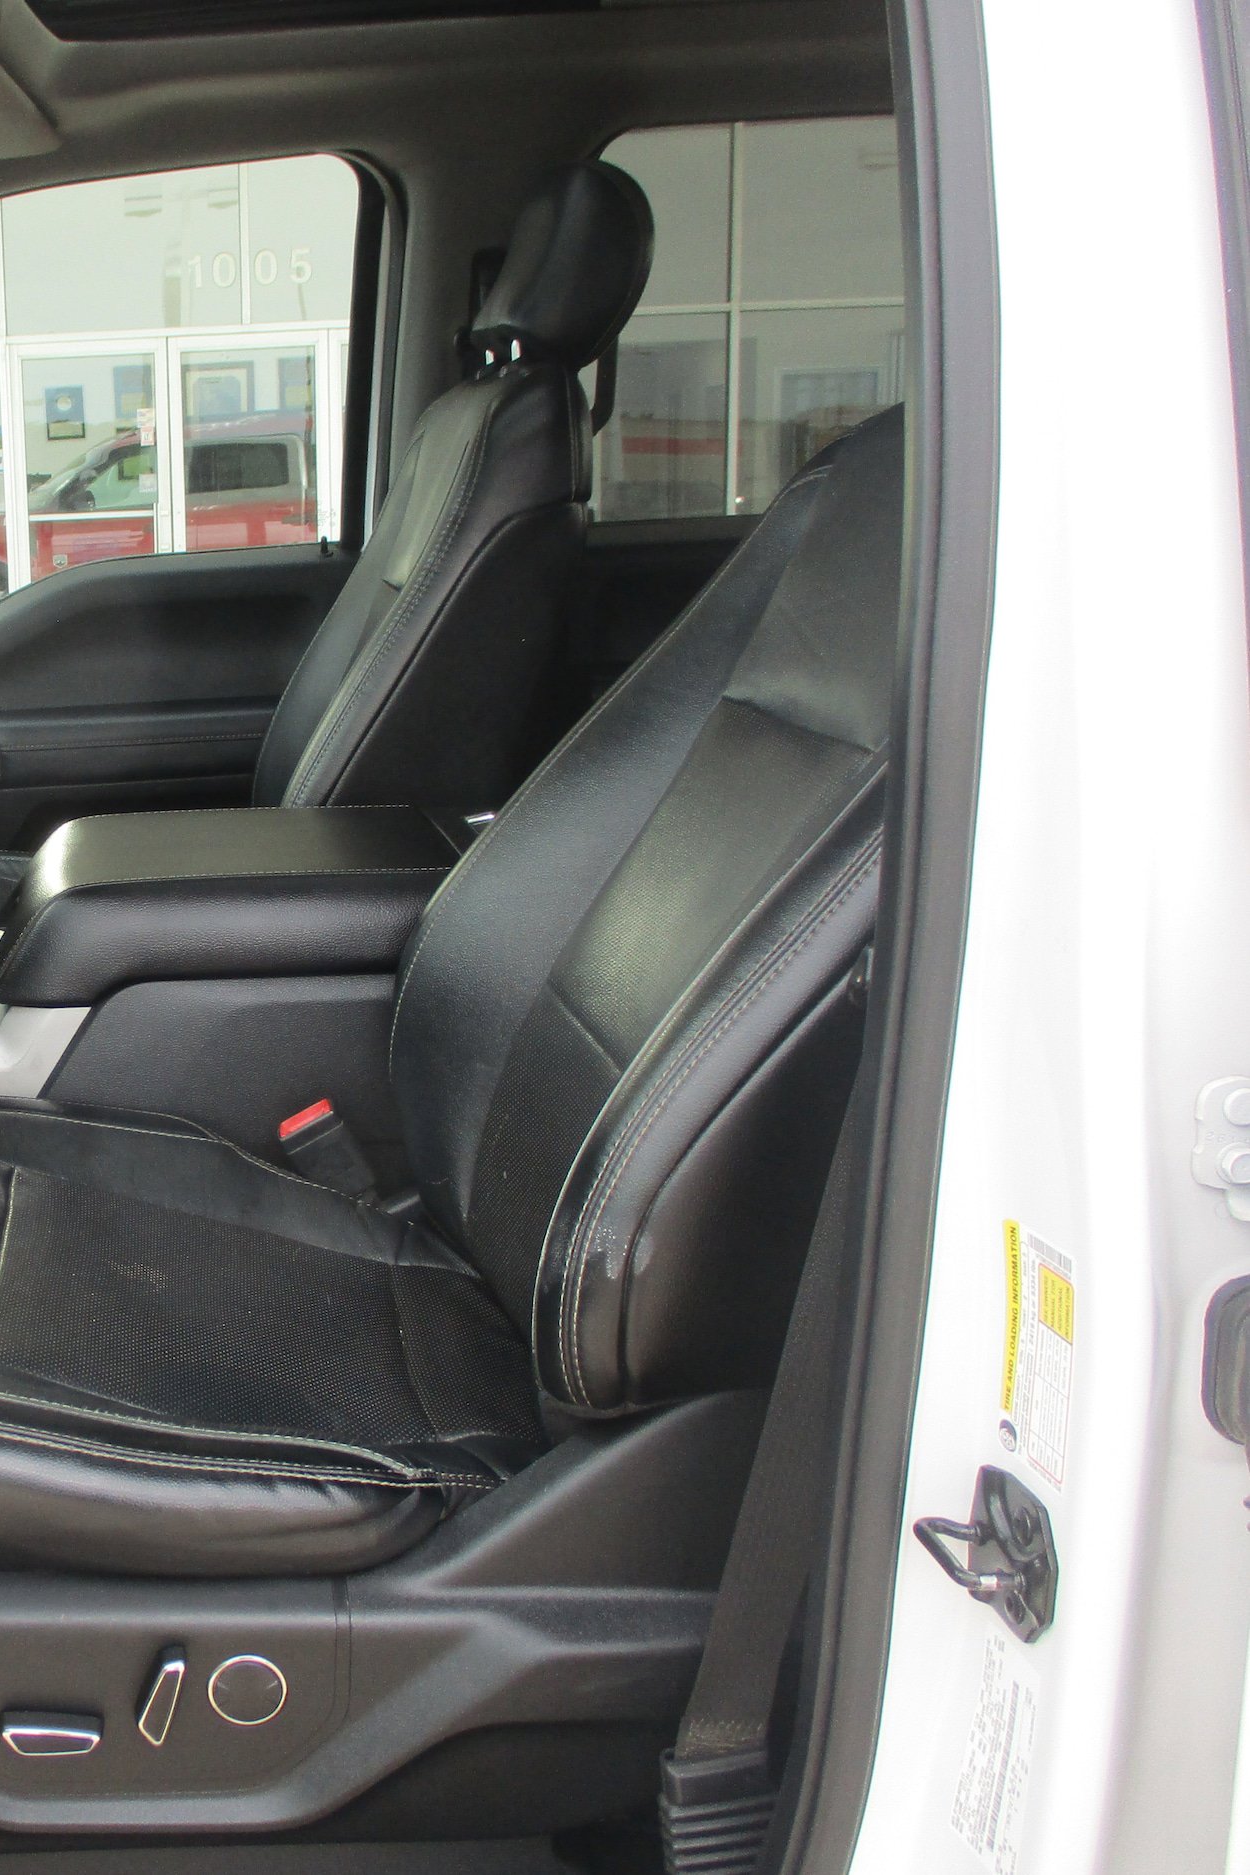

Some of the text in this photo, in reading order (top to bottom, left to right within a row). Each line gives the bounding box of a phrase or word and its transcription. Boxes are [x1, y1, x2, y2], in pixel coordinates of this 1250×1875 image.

[187, 248, 313, 288] 1005
[1009, 1225, 1019, 1306] INFORMATION
[1008, 1307, 1019, 1357] LOADING
